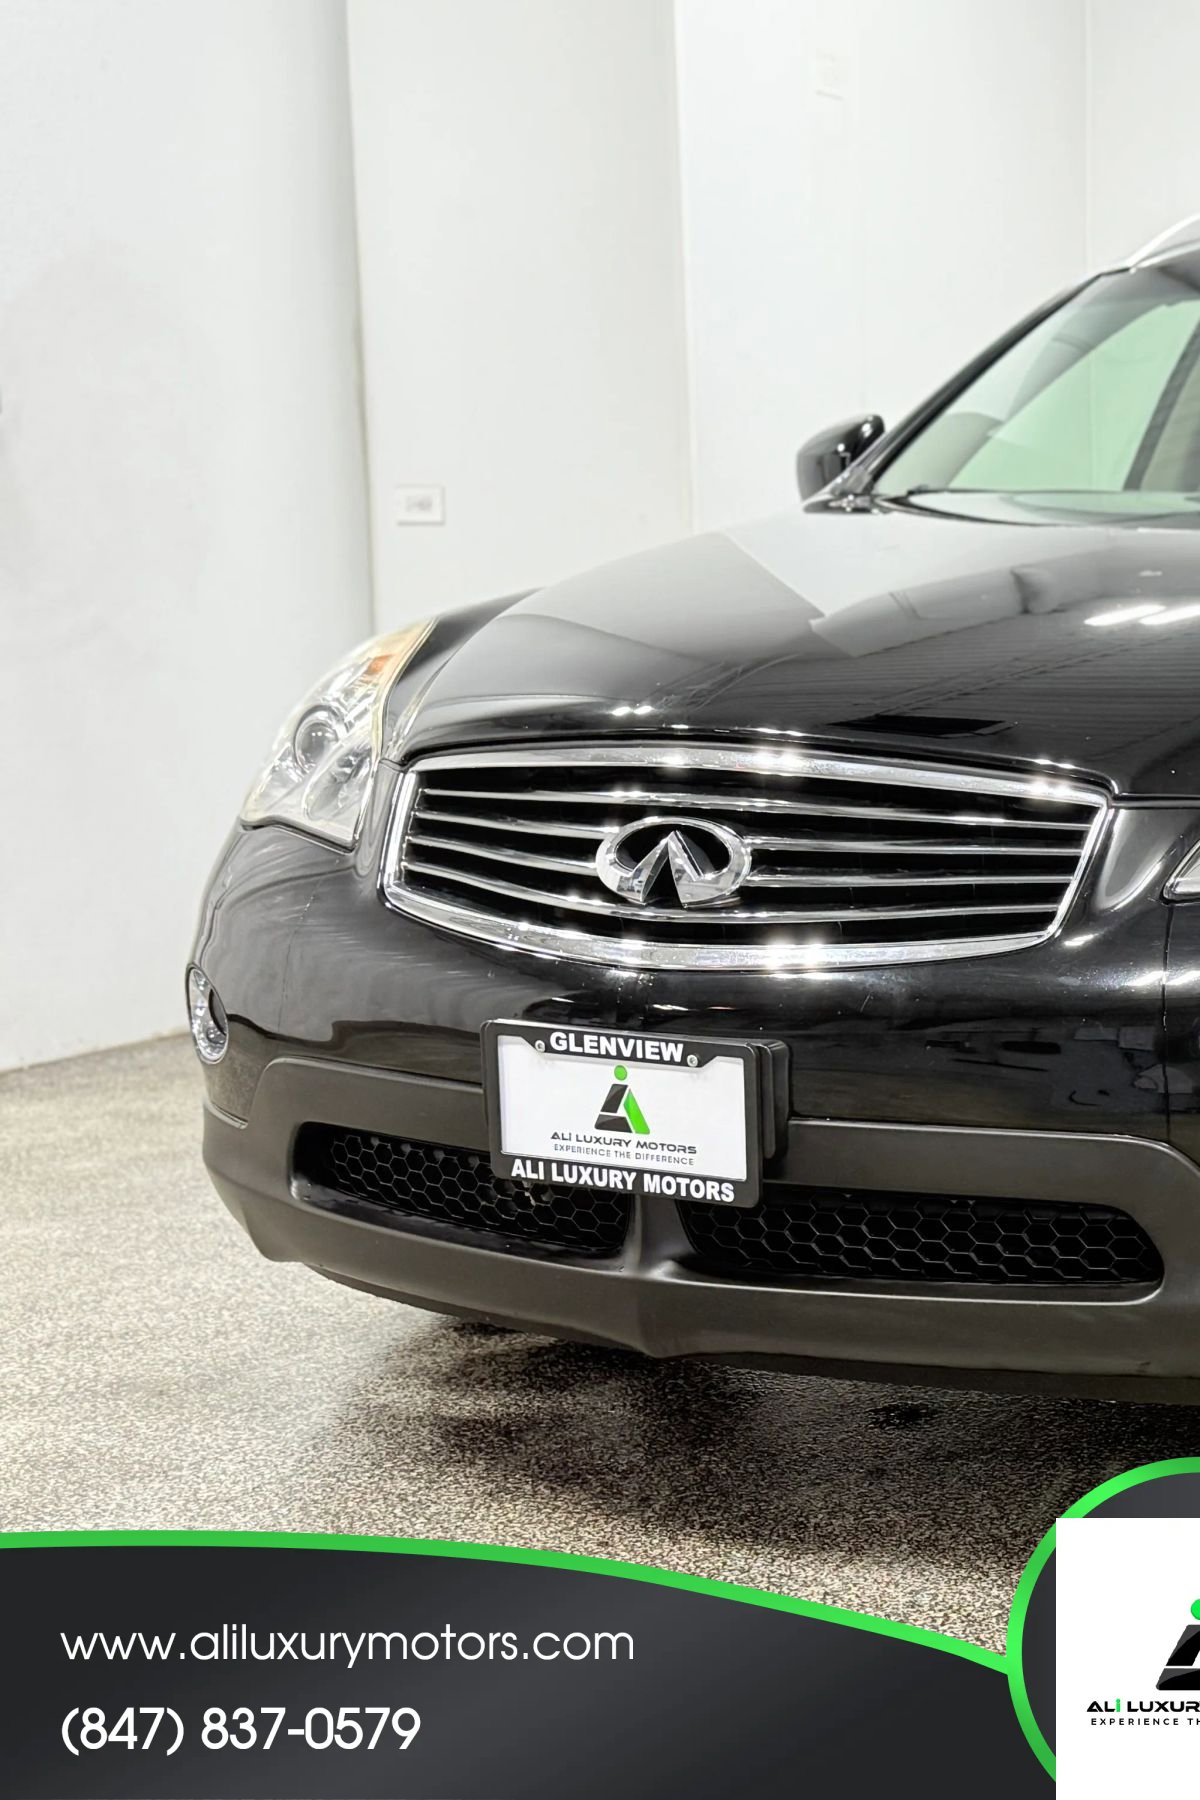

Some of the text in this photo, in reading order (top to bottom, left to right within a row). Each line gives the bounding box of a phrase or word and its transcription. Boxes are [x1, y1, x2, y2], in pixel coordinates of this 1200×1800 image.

[550, 1032, 684, 1062] GLENVIEW
[554, 1143, 695, 1165] EXPERIENCE THE DIFFERENCE
[575, 1134, 632, 1147] LUXURY
[636, 1140, 698, 1154] MOTORS
[511, 1159, 735, 1203] ALI LUXURY MOTORS
